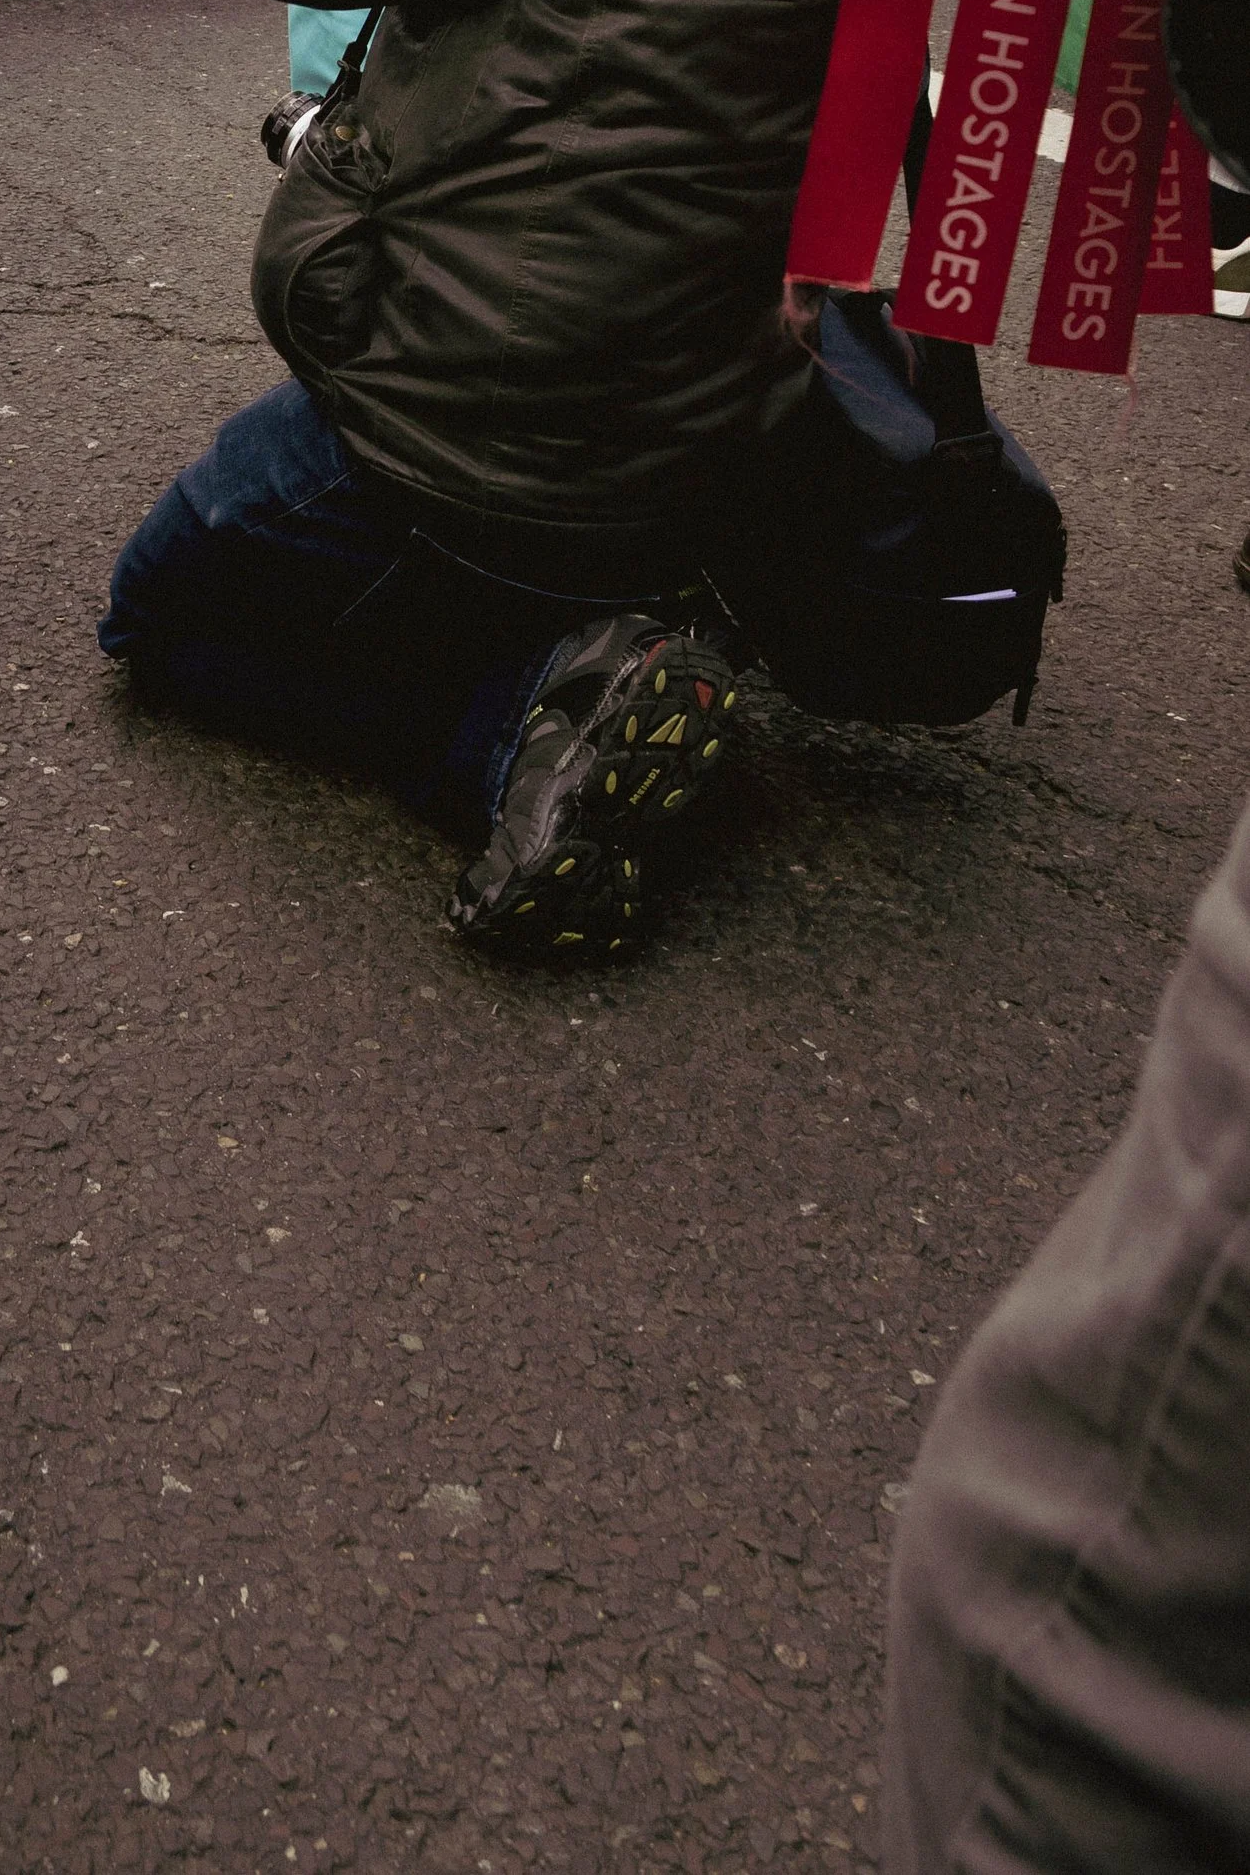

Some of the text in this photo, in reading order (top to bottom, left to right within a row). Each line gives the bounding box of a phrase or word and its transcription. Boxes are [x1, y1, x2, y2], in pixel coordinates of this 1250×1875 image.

[925, 29, 1030, 314] HOSTAGES
[1062, 61, 1150, 342] HOSTAGES
[628, 768, 661, 805] MEINDL
